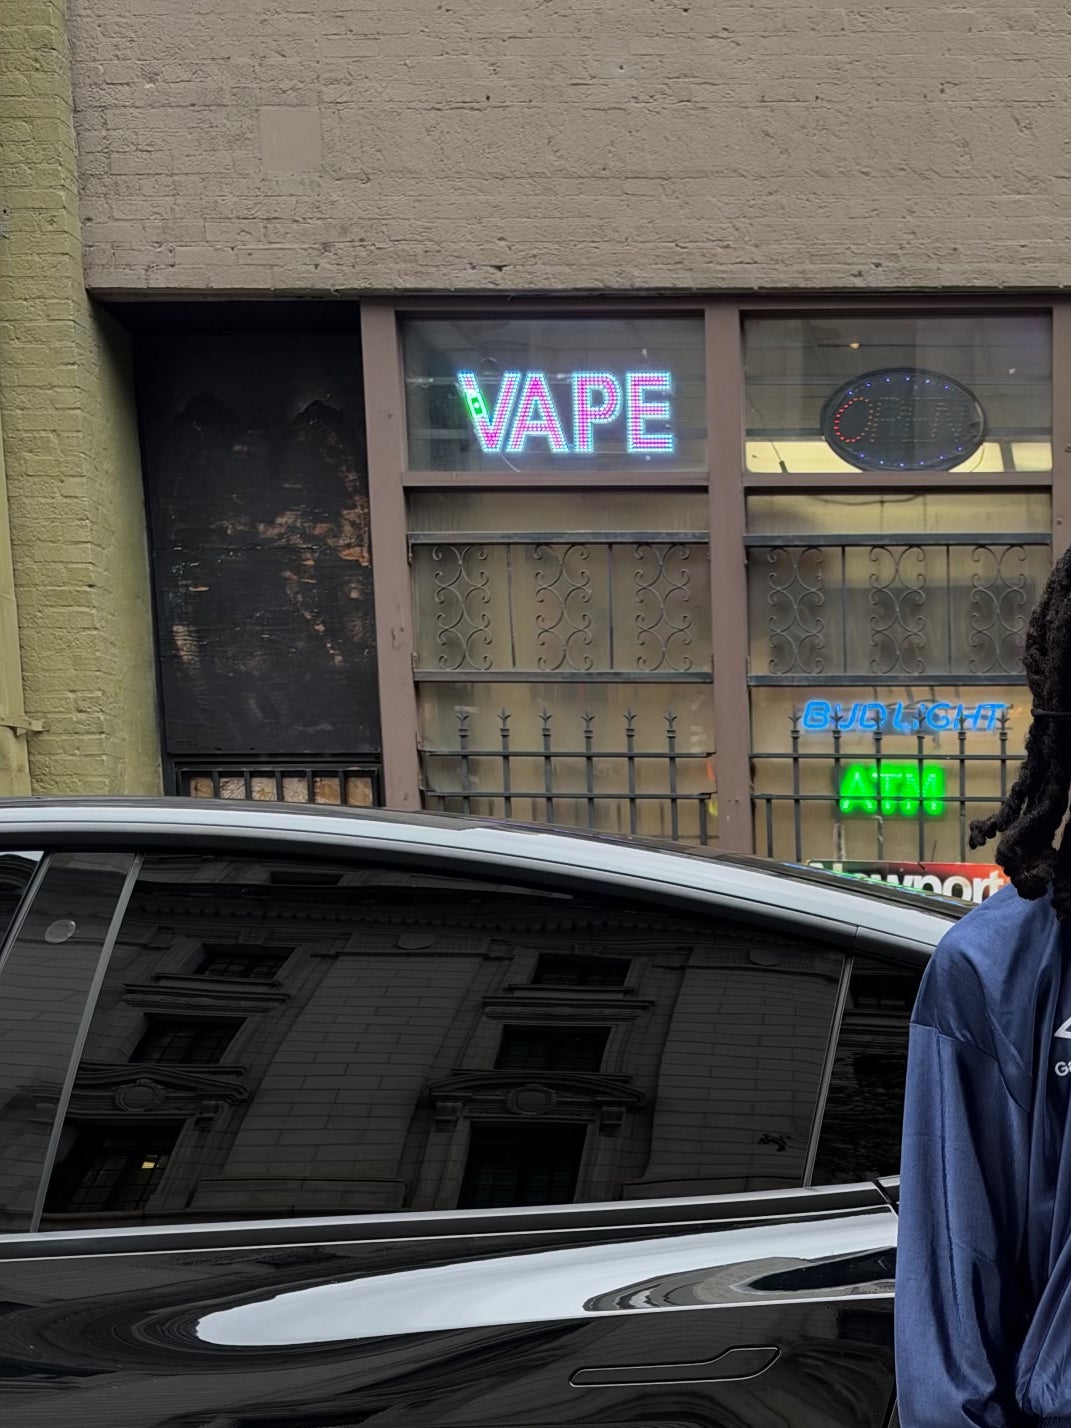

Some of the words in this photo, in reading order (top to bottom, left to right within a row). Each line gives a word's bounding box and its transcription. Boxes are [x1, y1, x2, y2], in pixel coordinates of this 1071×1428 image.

[457, 370, 674, 453] VAPE
[802, 700, 889, 731] BUD
[892, 700, 1007, 732] LIGHT
[841, 764, 945, 816] ATM
